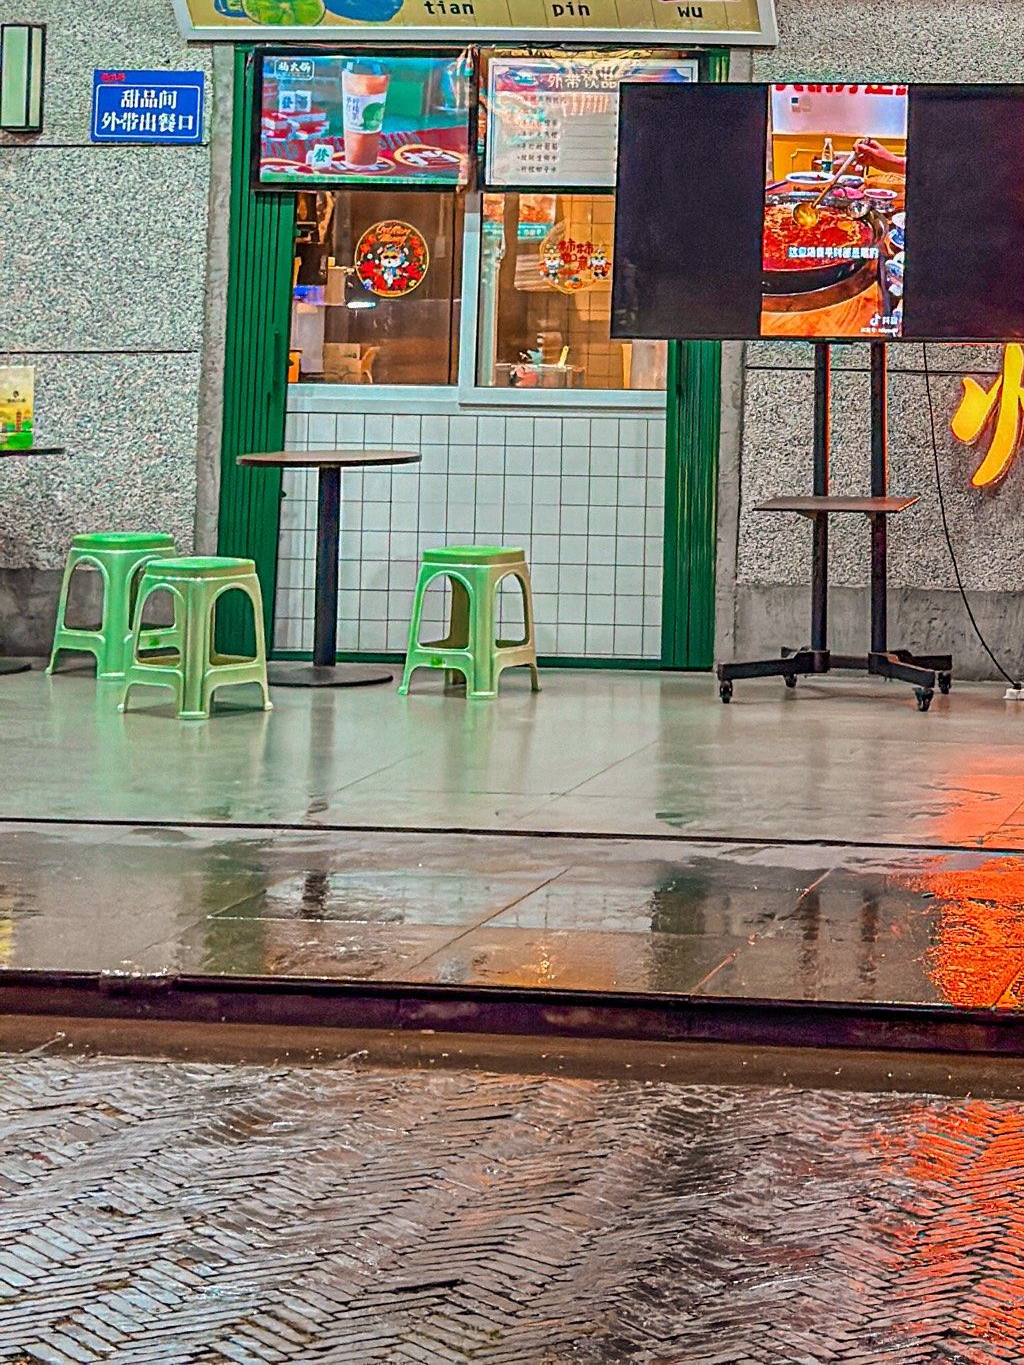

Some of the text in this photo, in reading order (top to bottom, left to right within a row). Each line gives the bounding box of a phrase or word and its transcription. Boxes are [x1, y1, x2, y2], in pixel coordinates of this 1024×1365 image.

[423, 0, 703, 18] tian pin wu
[547, 70, 618, 89] 外带饮品
[120, 89, 178, 110] 甜品间
[101, 111, 194, 133] 外带出餐口
